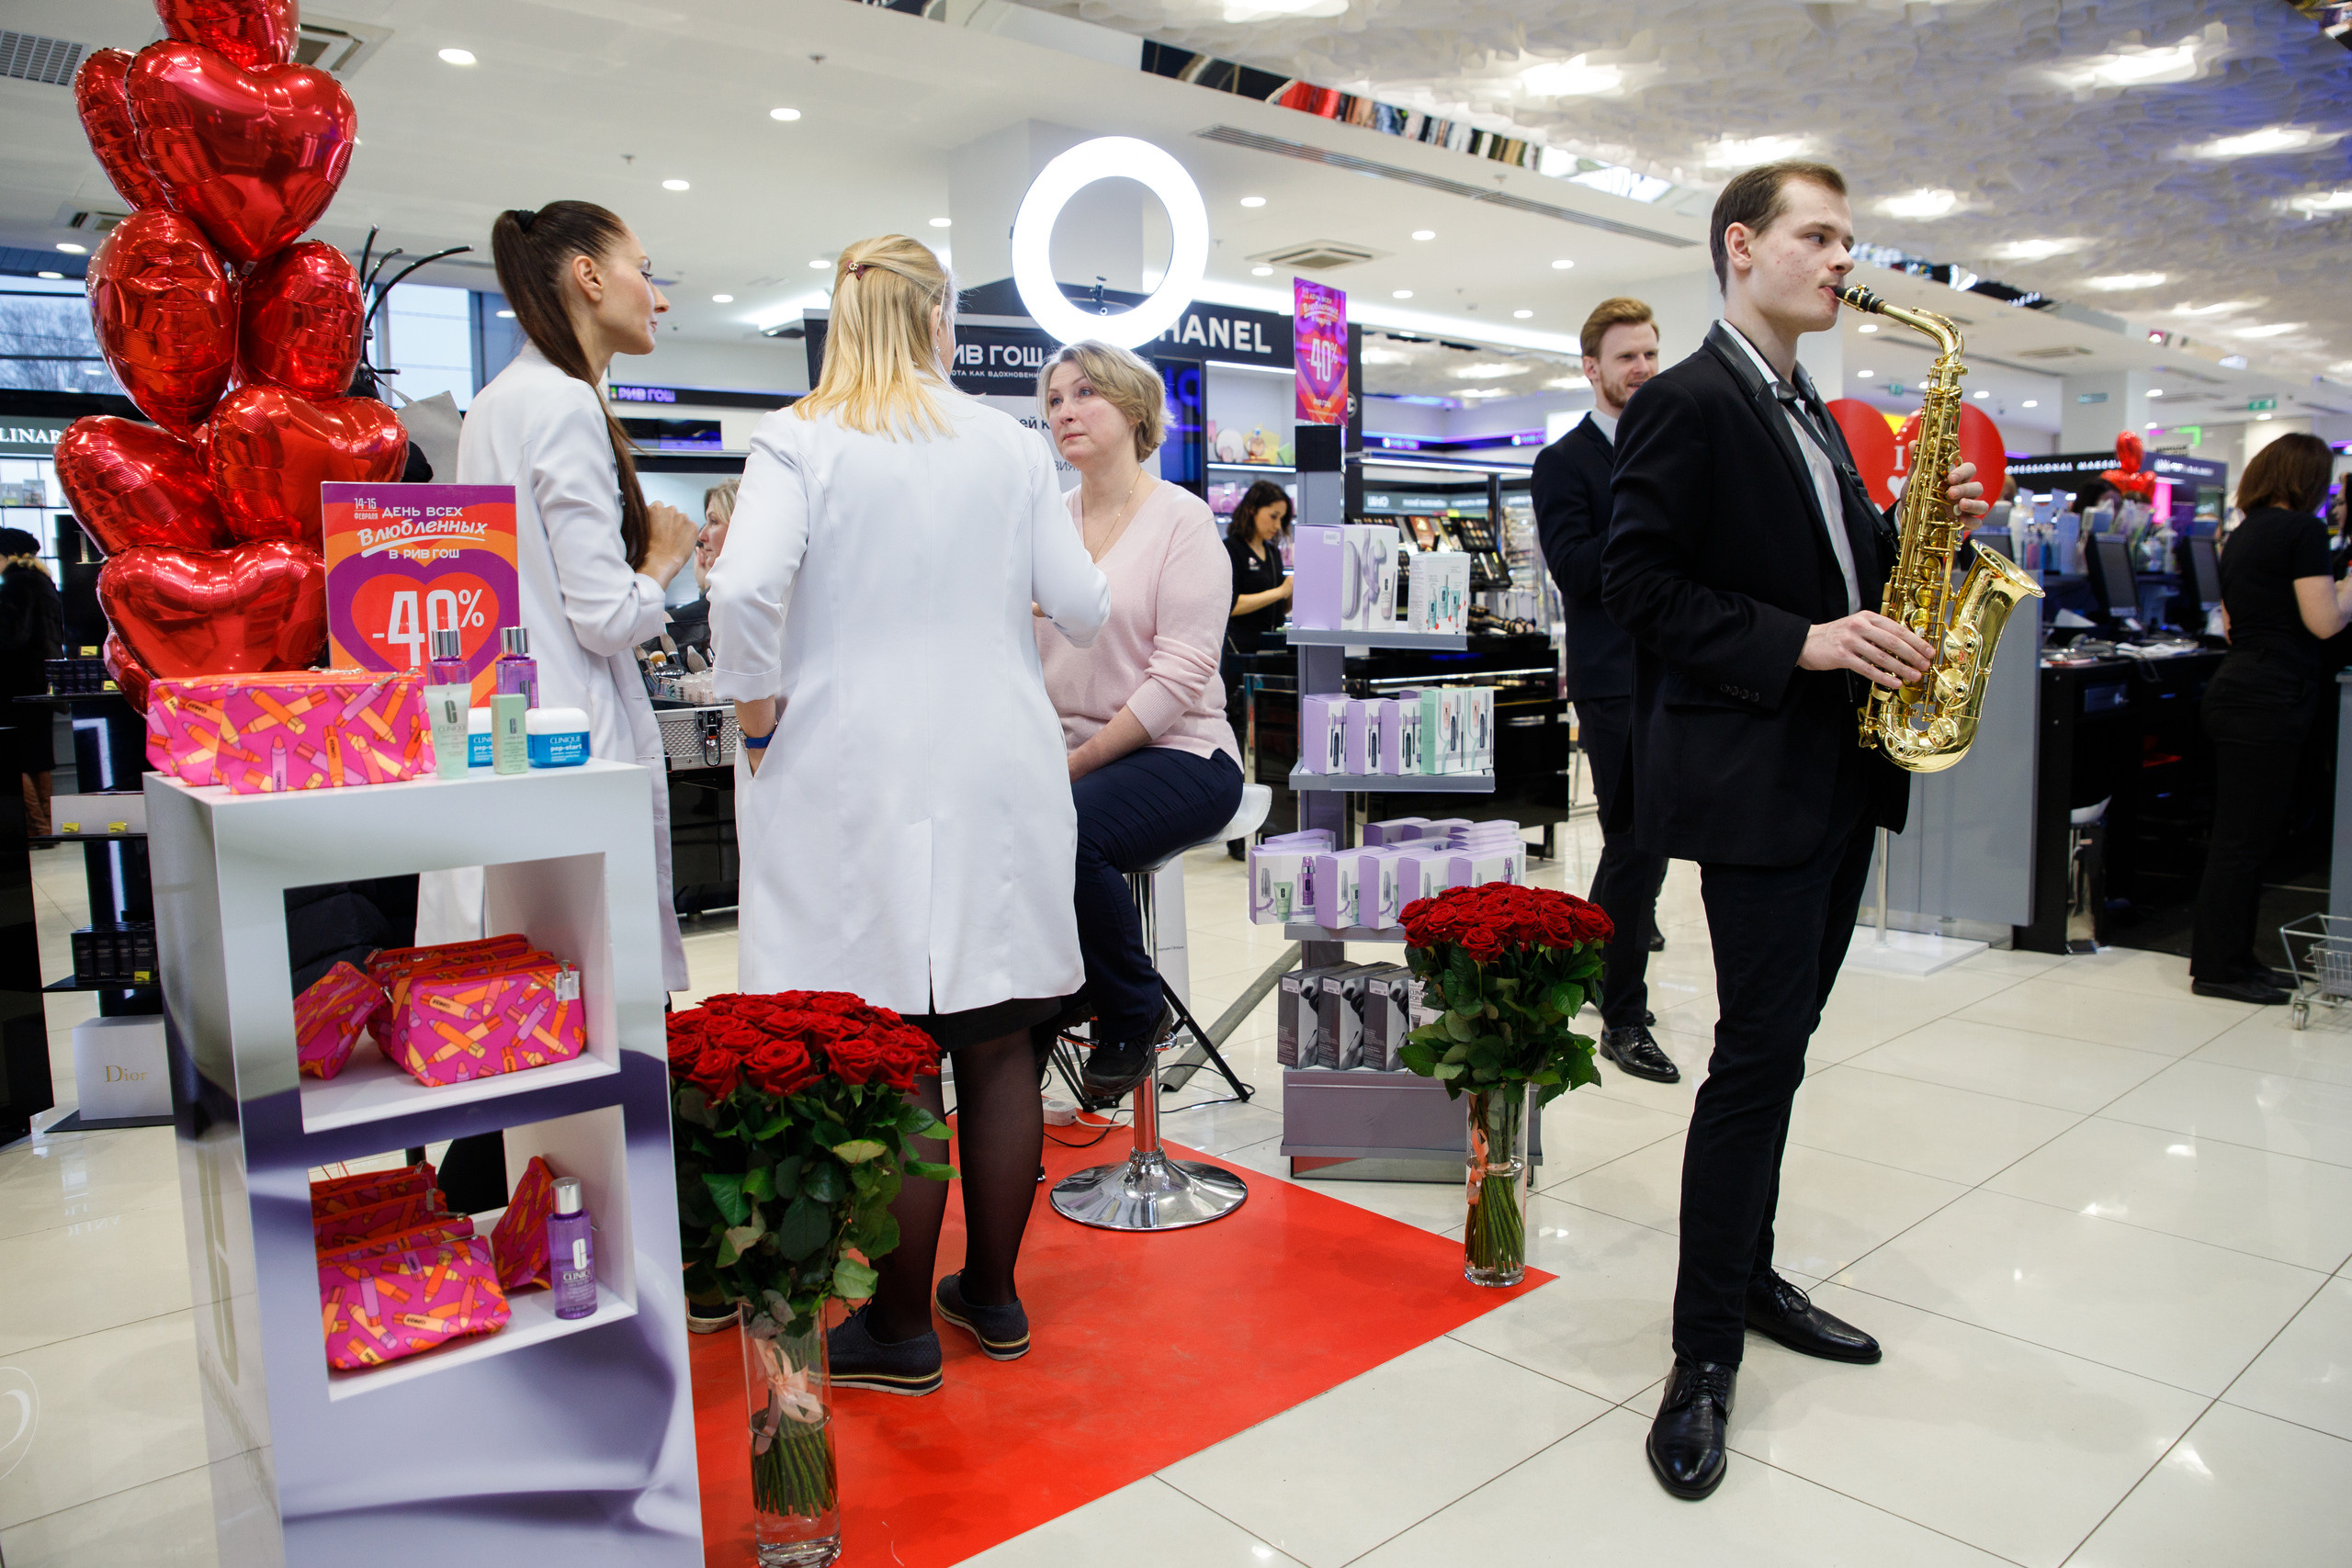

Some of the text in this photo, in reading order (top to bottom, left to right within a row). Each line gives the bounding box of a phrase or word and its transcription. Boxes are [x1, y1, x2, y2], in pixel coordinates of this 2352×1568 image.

[989, 345, 1044, 367] ГОШ
[1306, 338, 1338, 382] -40%
[618, 387, 675, 402] РИВ ГОШ
[1894, 446, 1905, 470] I
[354, 497, 377, 510] 14-15
[381, 506, 463, 518] ДЕНЬ ВСЕХ
[356, 518, 488, 547] Влюбленных
[389, 548, 459, 559] В РИВ ГОШ
[372, 589, 485, 667] -40%
[549, 735, 582, 744] CLINIQUE
[550, 743, 582, 752] pep-start
[104, 1065, 148, 1082] Dior
